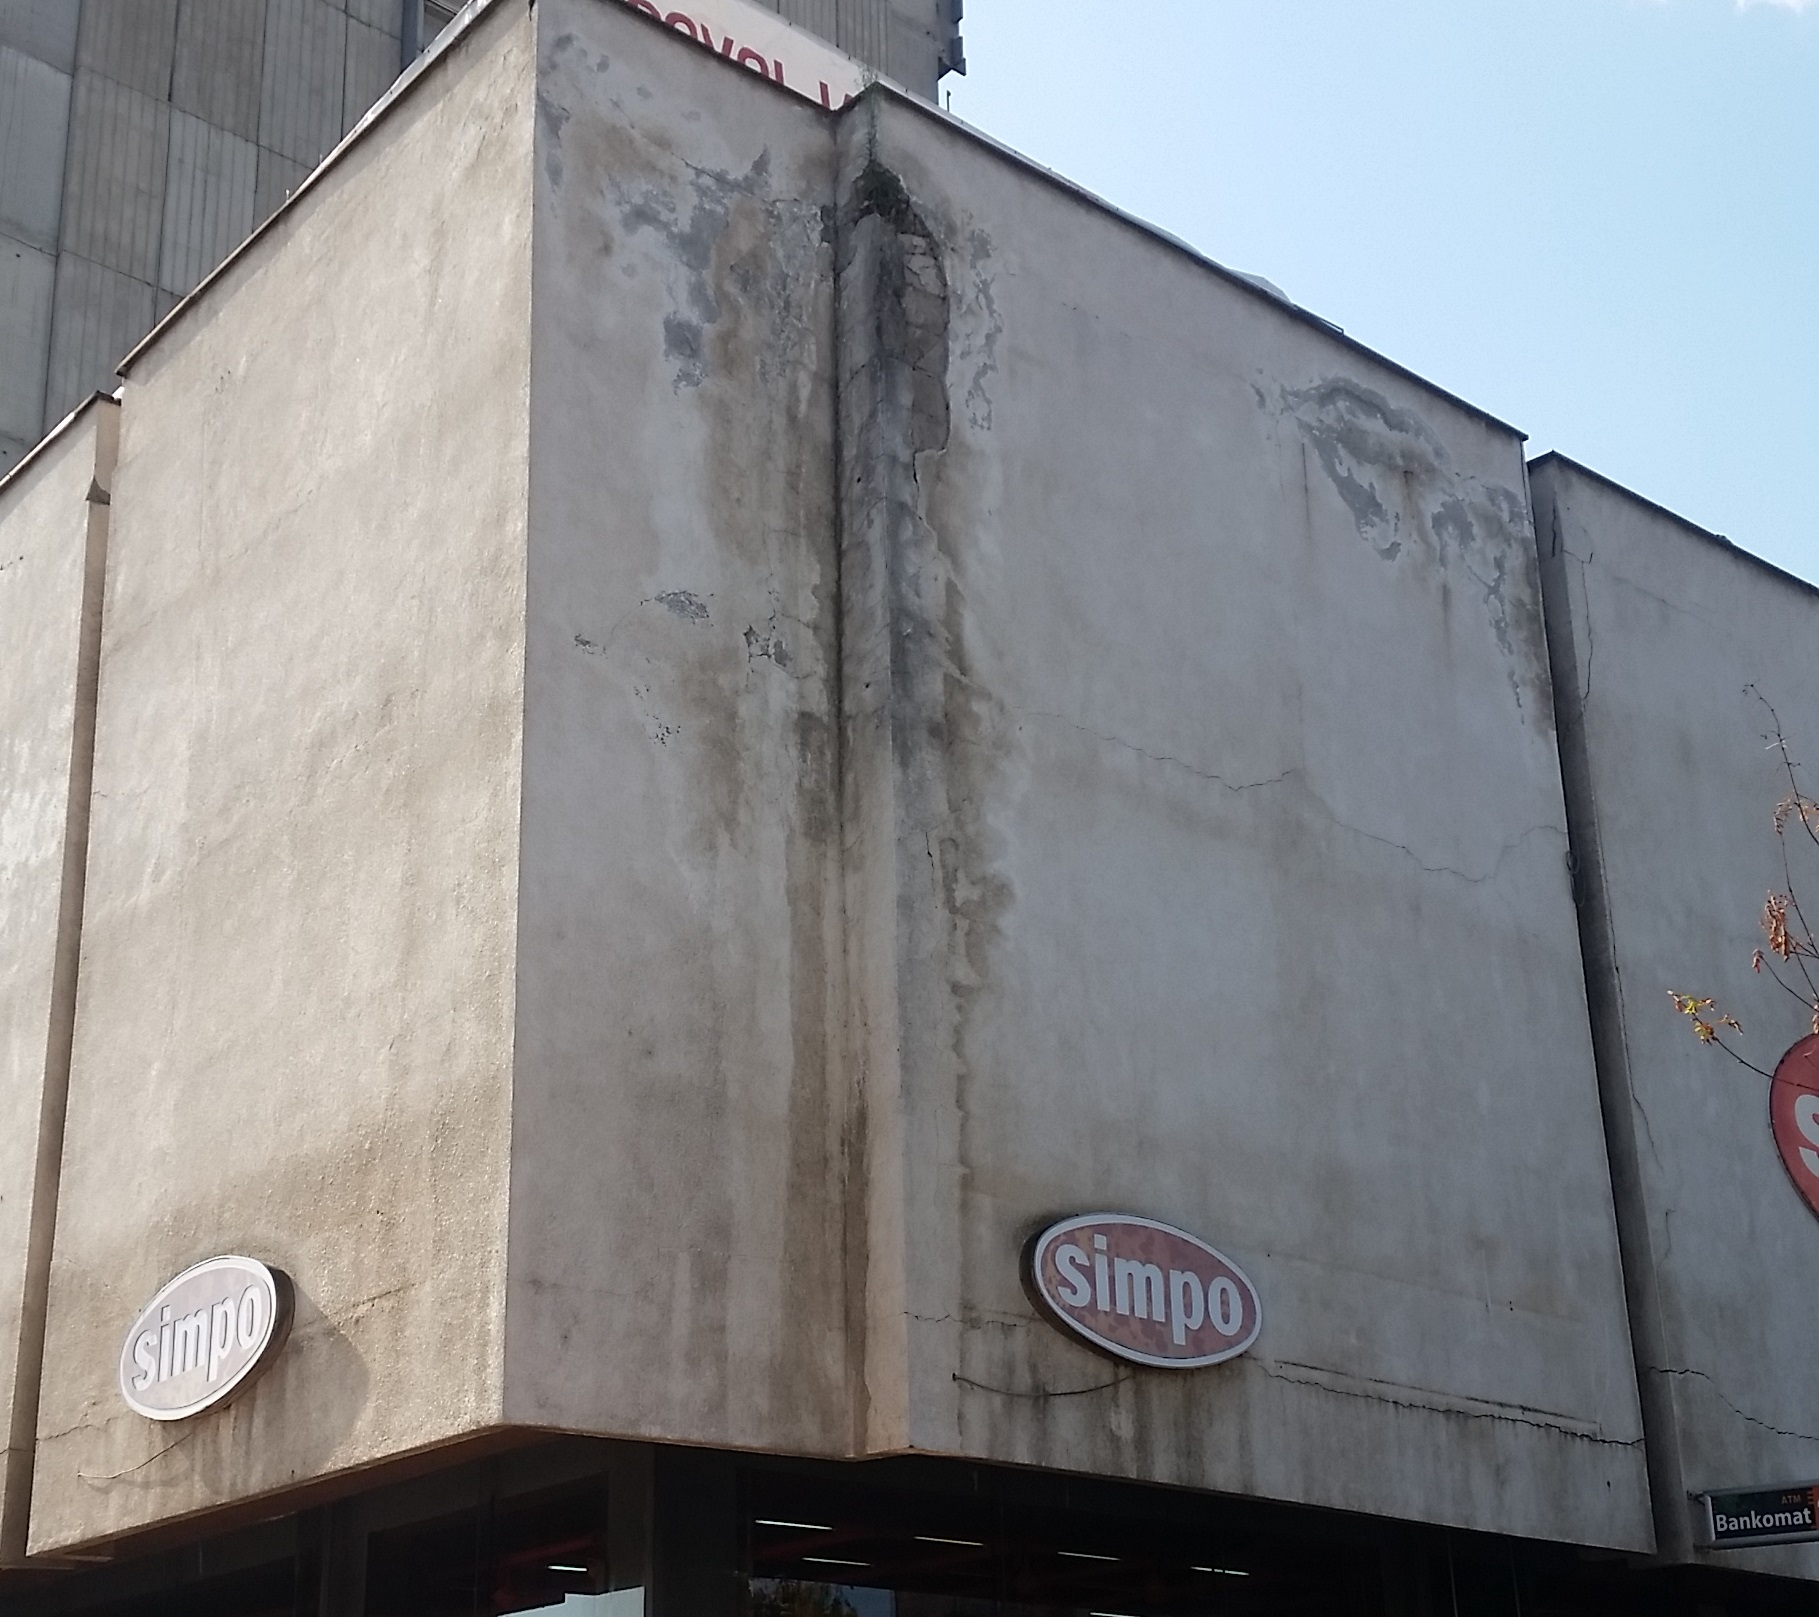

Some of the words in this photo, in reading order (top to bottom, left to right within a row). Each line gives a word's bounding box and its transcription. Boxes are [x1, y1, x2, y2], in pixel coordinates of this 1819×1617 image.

[1054, 1233, 1243, 1346] simpo
[131, 1284, 262, 1391] simpo
[1715, 1507, 1813, 1532] Bankomat
[1781, 1494, 1802, 1505] ATM
